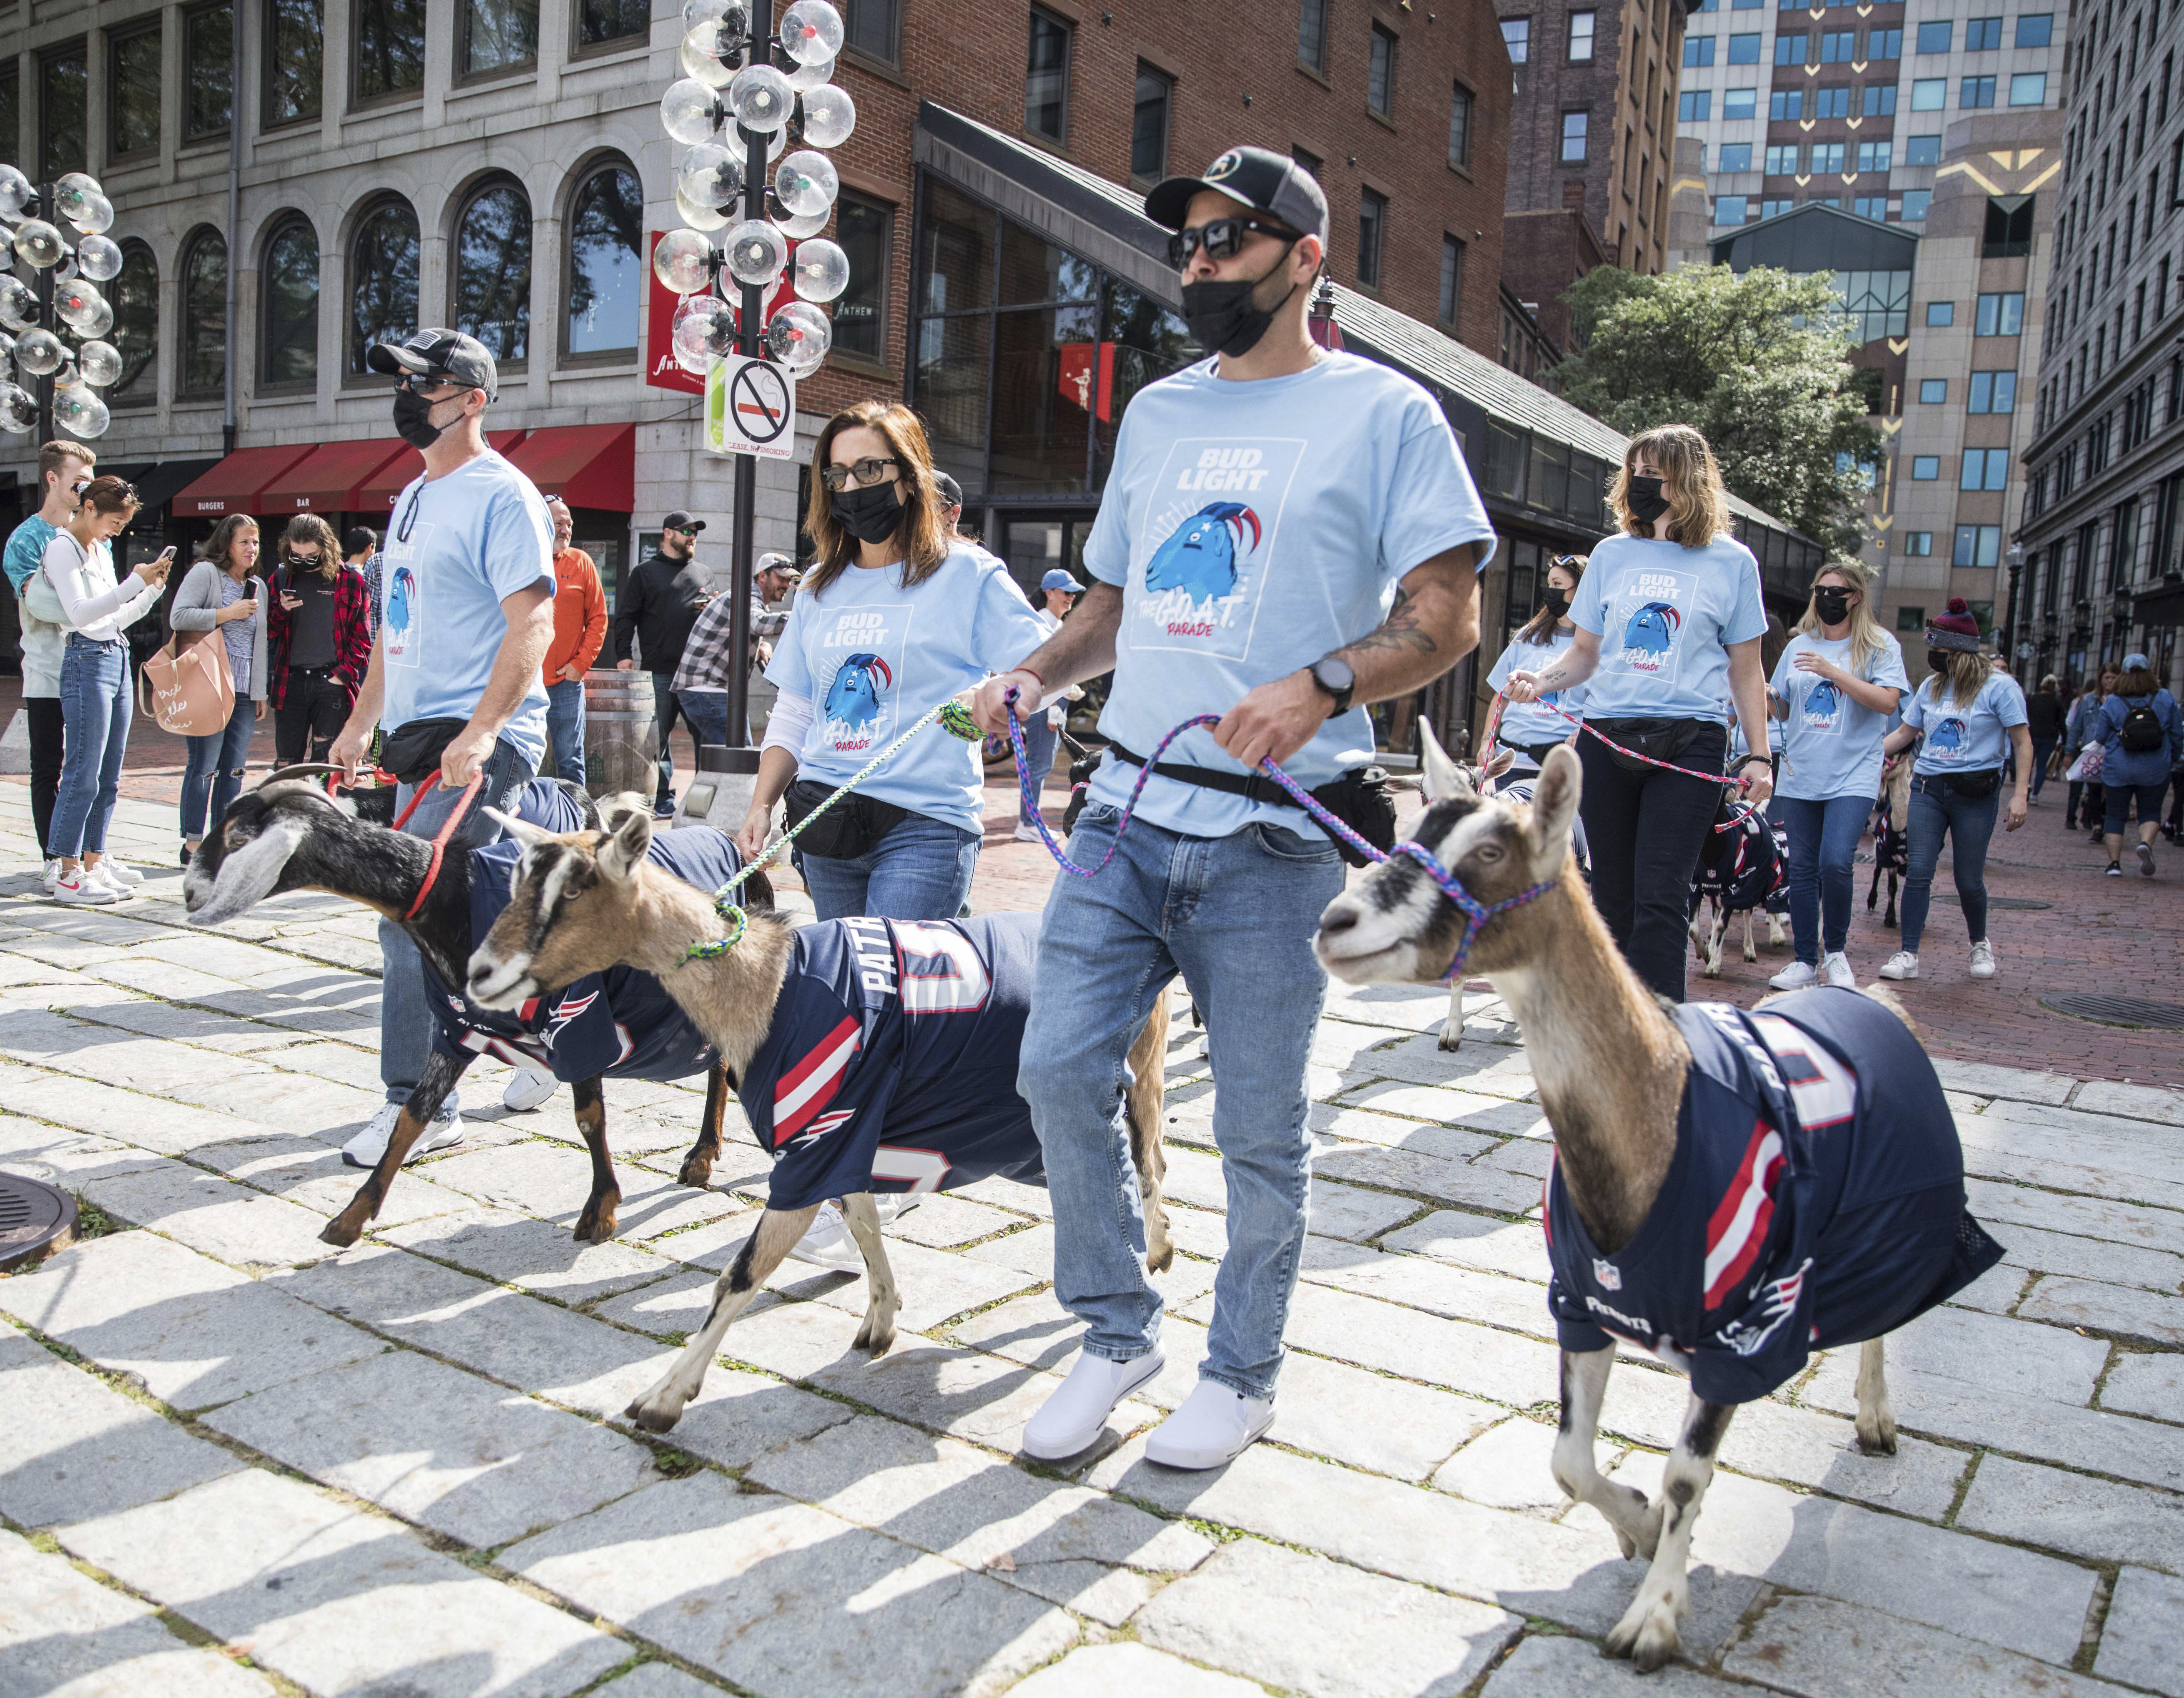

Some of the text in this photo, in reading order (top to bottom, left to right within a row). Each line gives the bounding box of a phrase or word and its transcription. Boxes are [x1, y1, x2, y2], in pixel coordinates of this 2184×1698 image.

[833, 301, 872, 320] ANTHEM
[1197, 448, 1263, 469] BUD
[1176, 468, 1269, 491] LIGHT
[198, 502, 225, 510] BURGERS
[296, 498, 310, 507] BAR
[387, 543, 416, 560] LIGHT
[1639, 573, 1676, 588] BUD
[1629, 585, 1681, 599] LIGHT
[1138, 588, 1246, 628] THE G.O.A.T.
[836, 613, 884, 630] BUD
[1167, 622, 1215, 636] PARADE
[823, 628, 889, 648] LIGHT
[1625, 647, 1672, 667] G.O.A.T.
[1634, 663, 1660, 671] PARADE
[1809, 713, 1840, 726] G.O.A.T.
[823, 715, 888, 746] G.O.A.T.
[835, 739, 871, 752] PARADE
